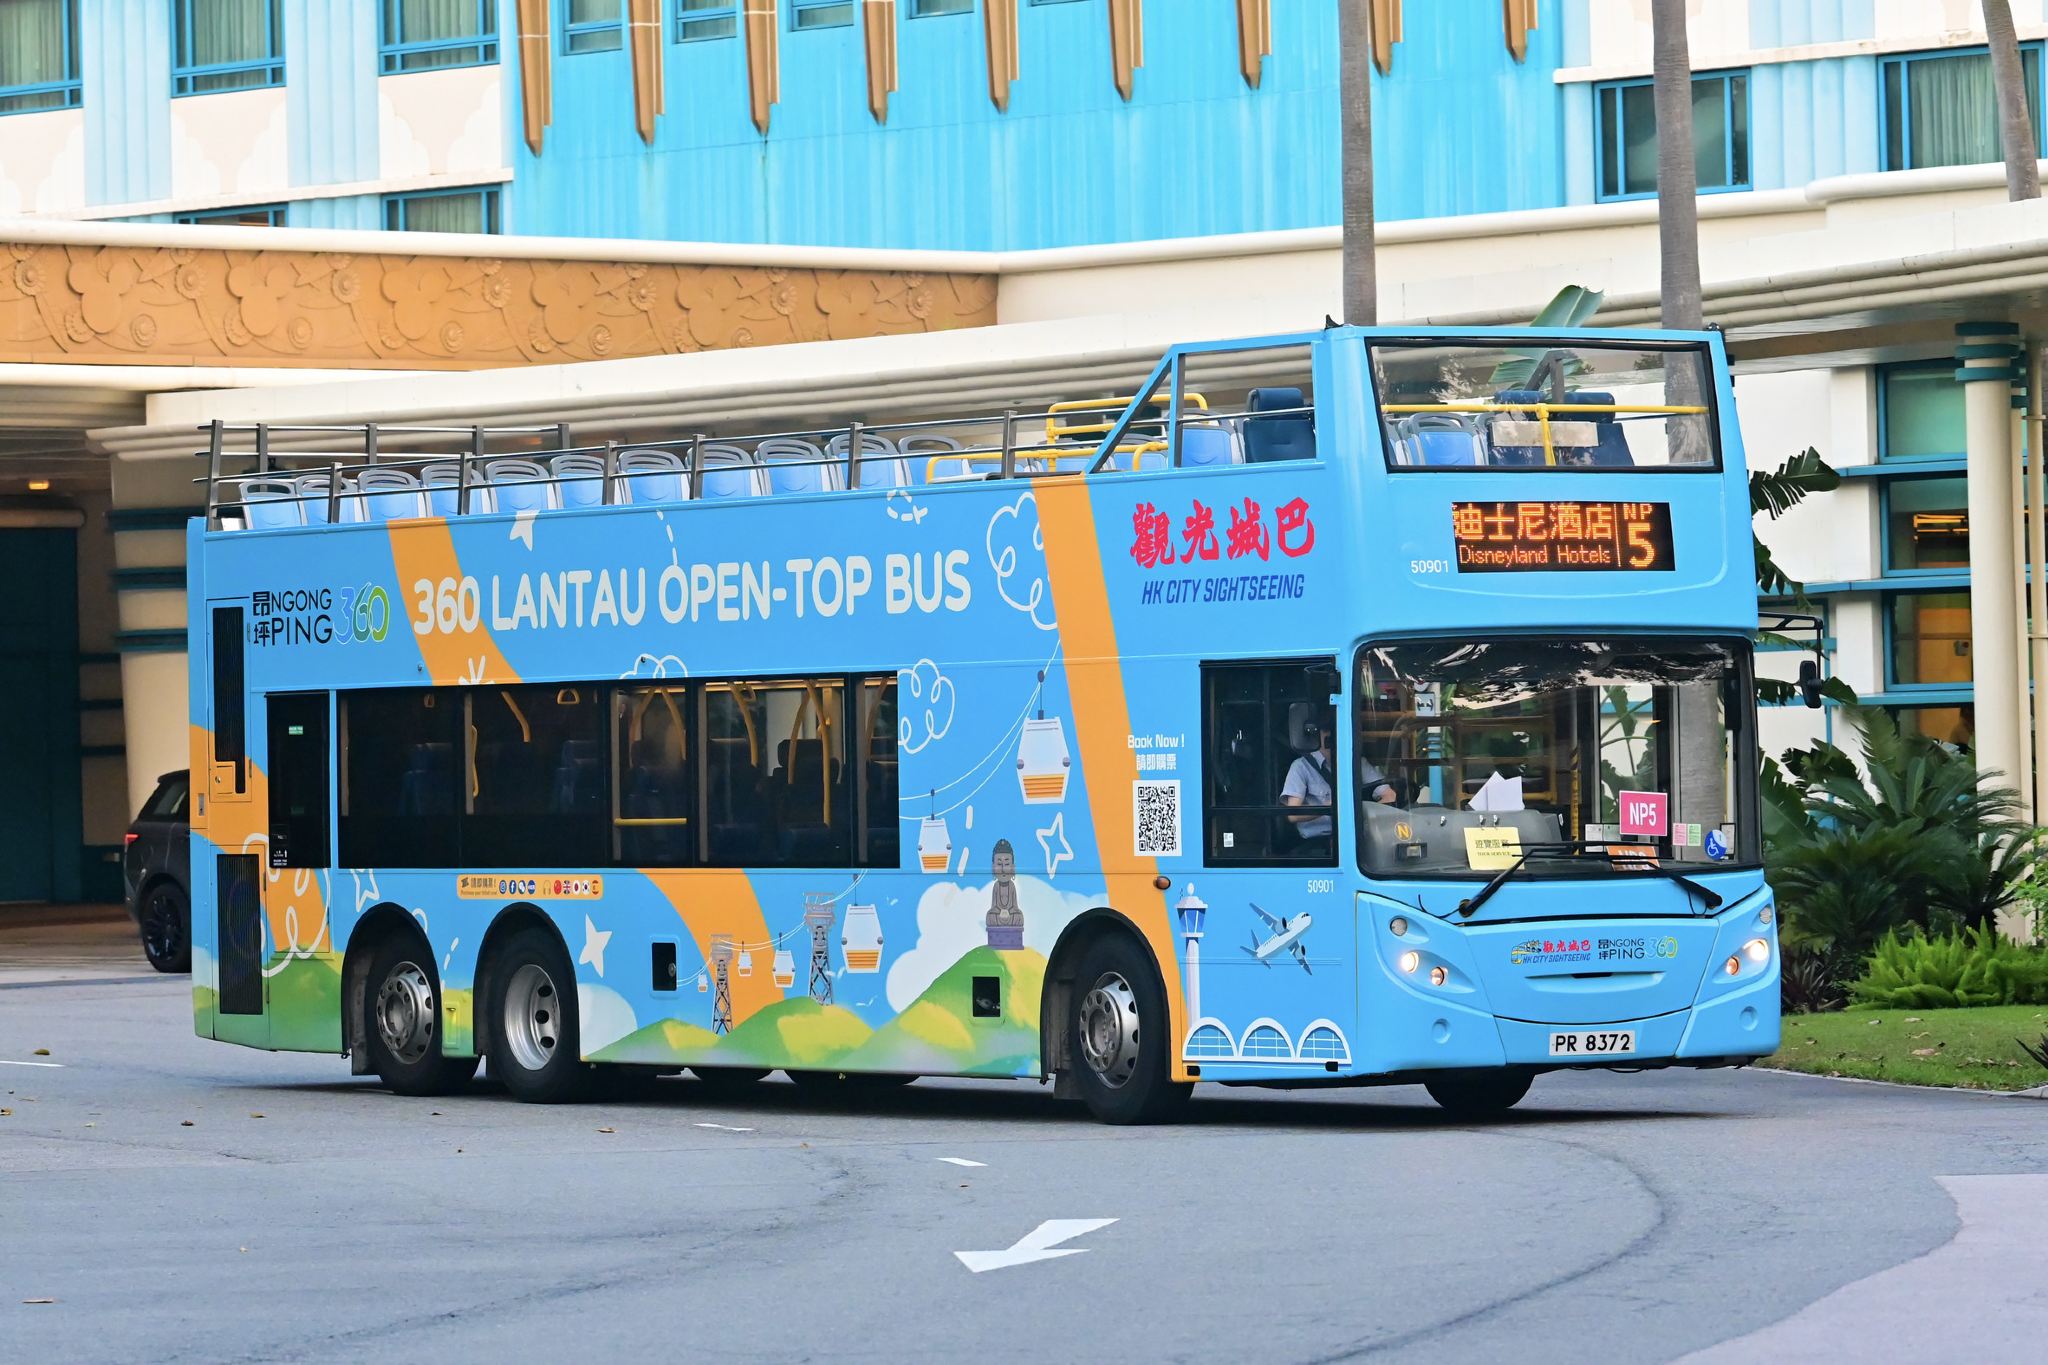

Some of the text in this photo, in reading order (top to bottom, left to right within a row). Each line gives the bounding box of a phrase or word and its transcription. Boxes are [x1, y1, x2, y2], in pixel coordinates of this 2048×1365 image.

[1452, 503, 1612, 540] 迪士尼酒店
[1623, 503, 1653, 520] NP
[1130, 497, 1315, 569] 觀光城巴
[1629, 522, 1655, 567] 5
[1410, 560, 1449, 574] 50901
[1459, 545, 1611, 568] Disneyland Hotels
[271, 588, 332, 613] NGONG
[413, 549, 971, 636] 360 LANTAU OPEN-TOP BUS
[1141, 573, 1305, 605] HK CITY SIGHTSEEING
[333, 582, 390, 645] 360
[271, 614, 333, 646] PING
[1127, 734, 1153, 748] Book
[1629, 802, 1657, 826] NP5
[1307, 879, 1334, 894] 50901
[1609, 938, 1645, 947] NGONG
[1609, 947, 1645, 960] PING
[1533, 954, 1550, 963] CITY
[1549, 952, 1591, 962] SIGHTSEEING
[1555, 1034, 1630, 1052] PR 8372
